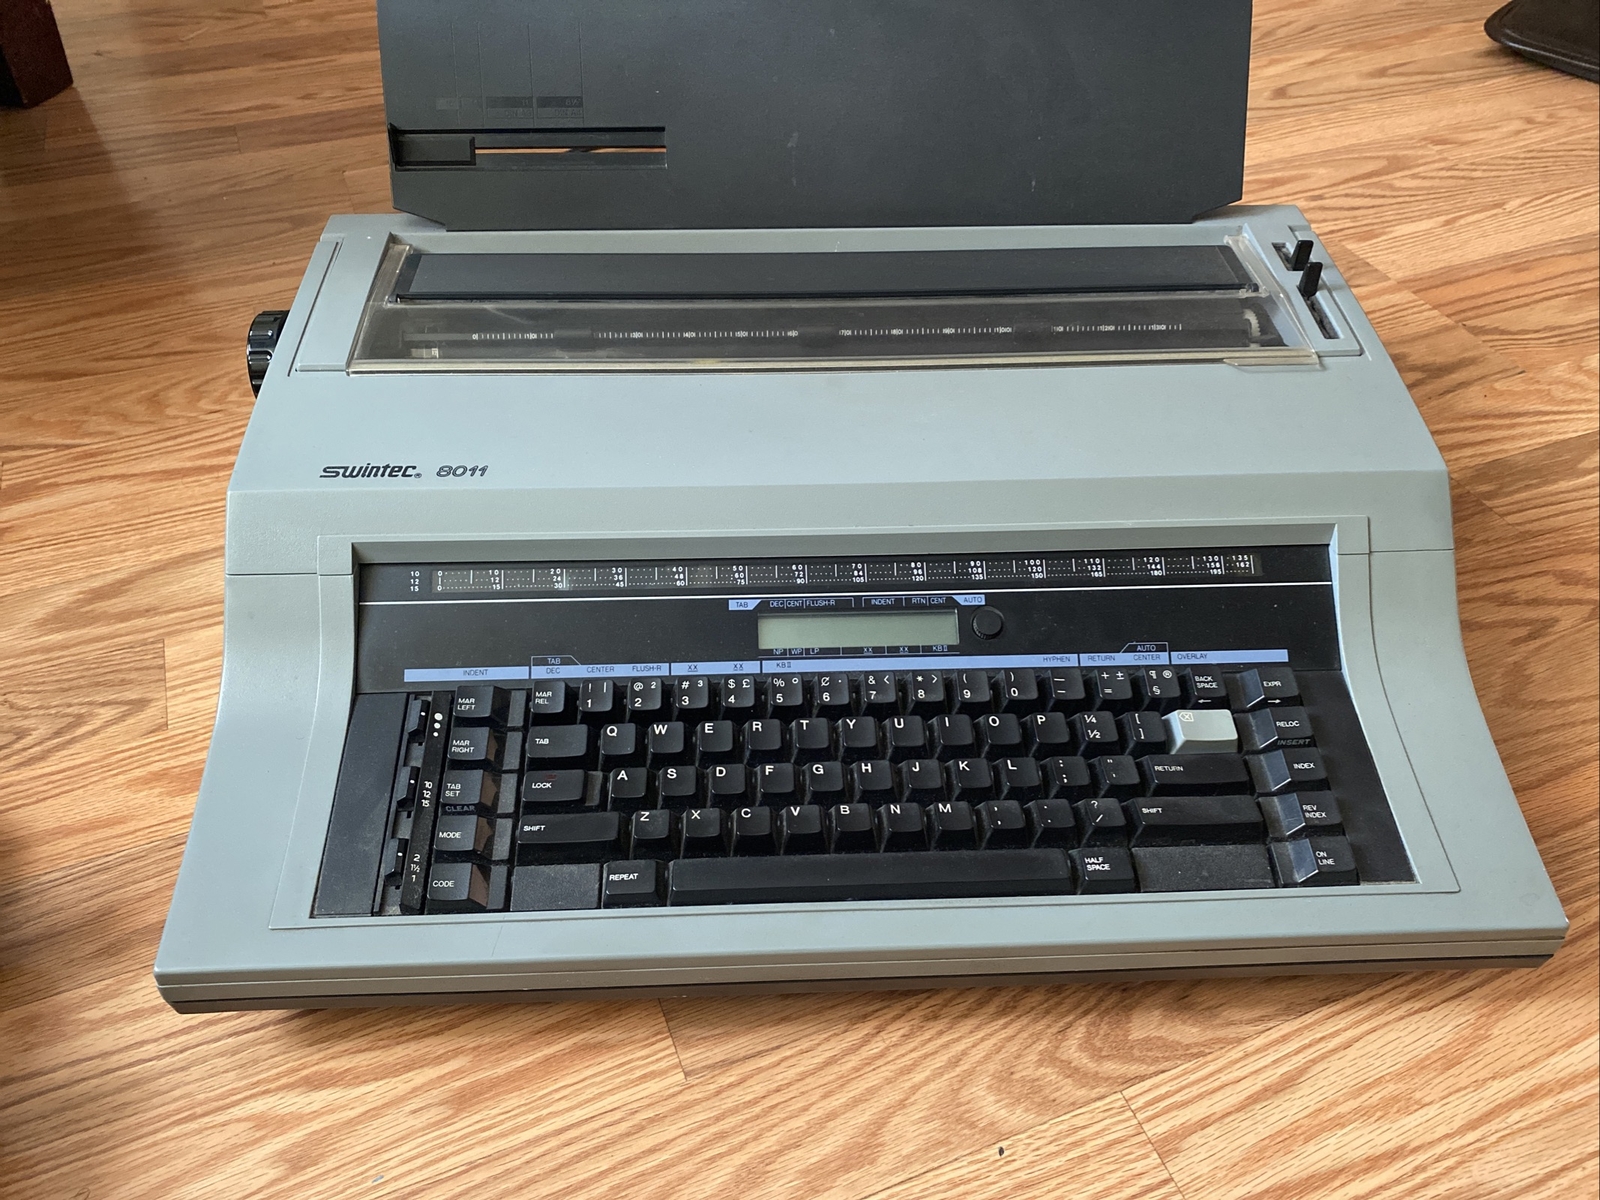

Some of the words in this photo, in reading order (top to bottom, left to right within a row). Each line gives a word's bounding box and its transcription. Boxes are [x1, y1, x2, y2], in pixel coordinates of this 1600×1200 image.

[436, 464, 489, 478] 8011
[769, 600, 784, 608] DEC
[786, 600, 802, 608] CENT
[806, 598, 836, 607] FLUSH-R
[912, 597, 926, 605] RTN
[930, 596, 946, 604] CENT
[1176, 652, 1208, 660] OVERLAY
[586, 666, 615, 674] CENTER
[632, 664, 662, 672] FLUSH-R
[822, 692, 830, 702] 6
[869, 691, 877, 700] 7
[917, 689, 926, 698] 8
[963, 689, 971, 698] 9
[1010, 688, 1019, 697] 0
[586, 699, 592, 708] 1
[634, 698, 642, 707] 2
[682, 696, 690, 705] 3
[728, 695, 736, 704] 4
[776, 694, 784, 703] 5
[800, 720, 810, 730] T
[846, 718, 856, 729] Y
[894, 718, 904, 728] U
[944, 717, 950, 727] I
[988, 716, 1000, 726] O
[1037, 715, 1046, 725] P
[606, 726, 618, 738] Q
[653, 724, 668, 735] W
[704, 723, 714, 733] E
[752, 722, 762, 732] R
[812, 764, 824, 775] G
[861, 762, 872, 773] H
[912, 762, 920, 772] J
[959, 760, 970, 772] K
[1007, 760, 1017, 770] L
[616, 770, 628, 781] A
[666, 768, 677, 779] S
[716, 767, 726, 777] D
[765, 766, 774, 776] F
[422, 800, 430, 808] 15
[890, 804, 900, 814] N
[938, 803, 952, 813] M
[741, 808, 752, 818] C
[790, 806, 800, 816] V
[840, 805, 850, 814] B
[640, 812, 650, 822] Z
[691, 810, 701, 820] X
[438, 831, 462, 839] MODE
[414, 854, 421, 862] 2
[608, 873, 638, 882] REPEAT
[432, 880, 455, 888] CODE
